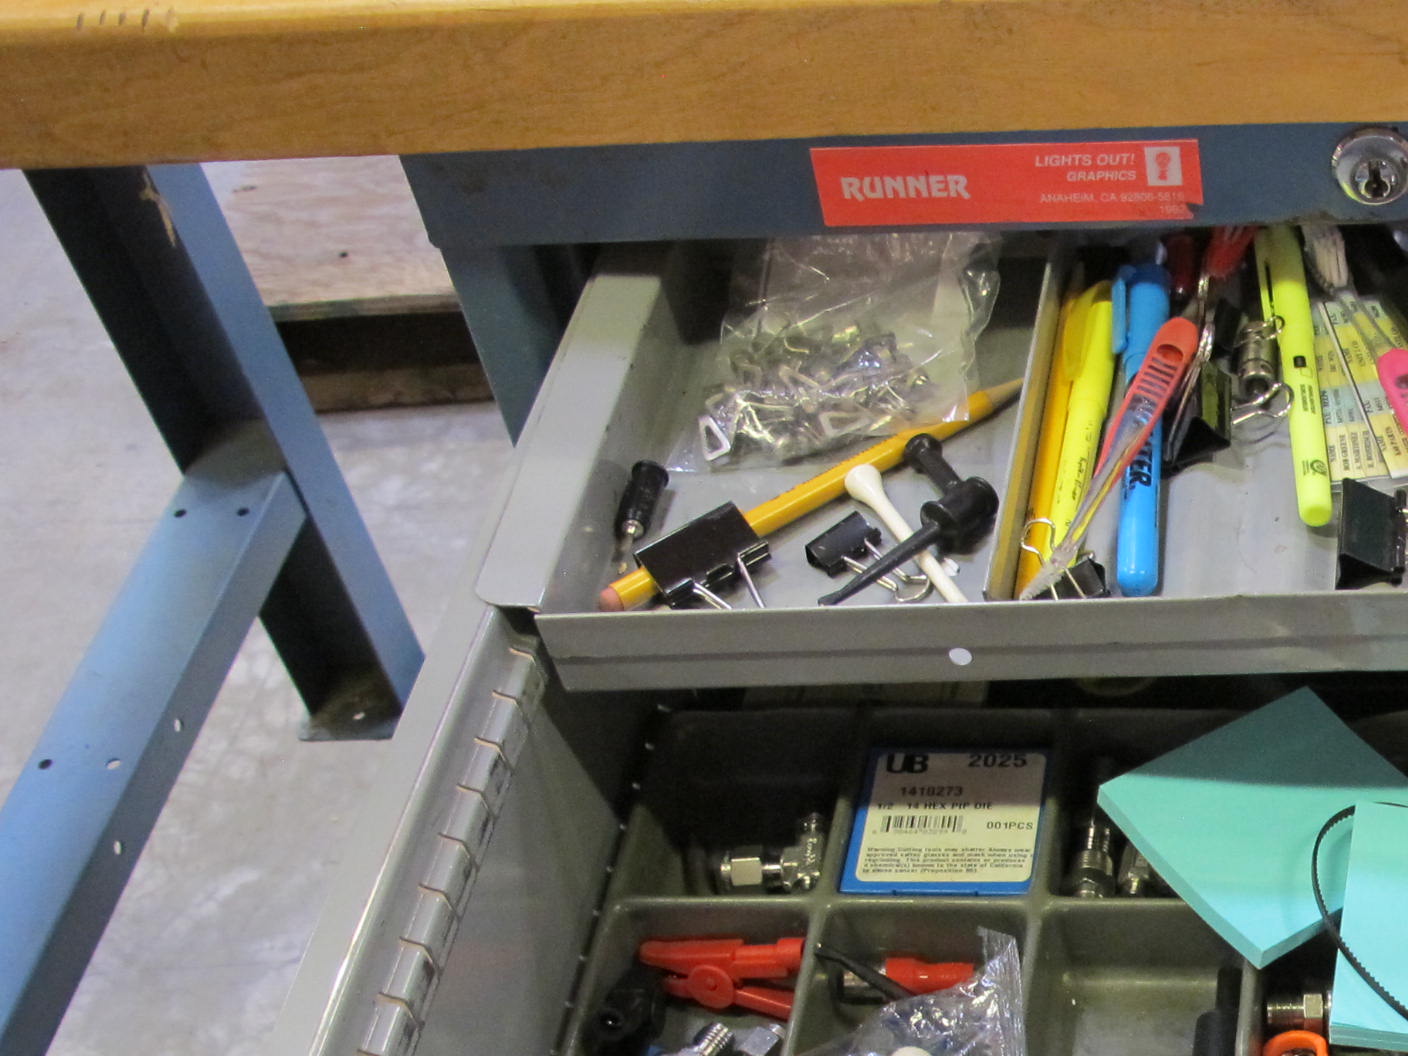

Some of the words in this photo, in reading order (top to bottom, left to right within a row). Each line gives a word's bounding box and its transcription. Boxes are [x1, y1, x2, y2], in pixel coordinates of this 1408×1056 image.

[1035, 154, 1093, 167] LIGHTS
[1097, 153, 1136, 165] OUT!
[1066, 170, 1137, 182] GRAPHICS
[840, 174, 972, 202] RUNNER
[1100, 192, 1117, 202] CA
[886, 753, 930, 775] UB
[967, 753, 1028, 769] 2025
[923, 802, 947, 810] HEX
[950, 802, 971, 810] PIP
[974, 802, 994, 810] DIE
